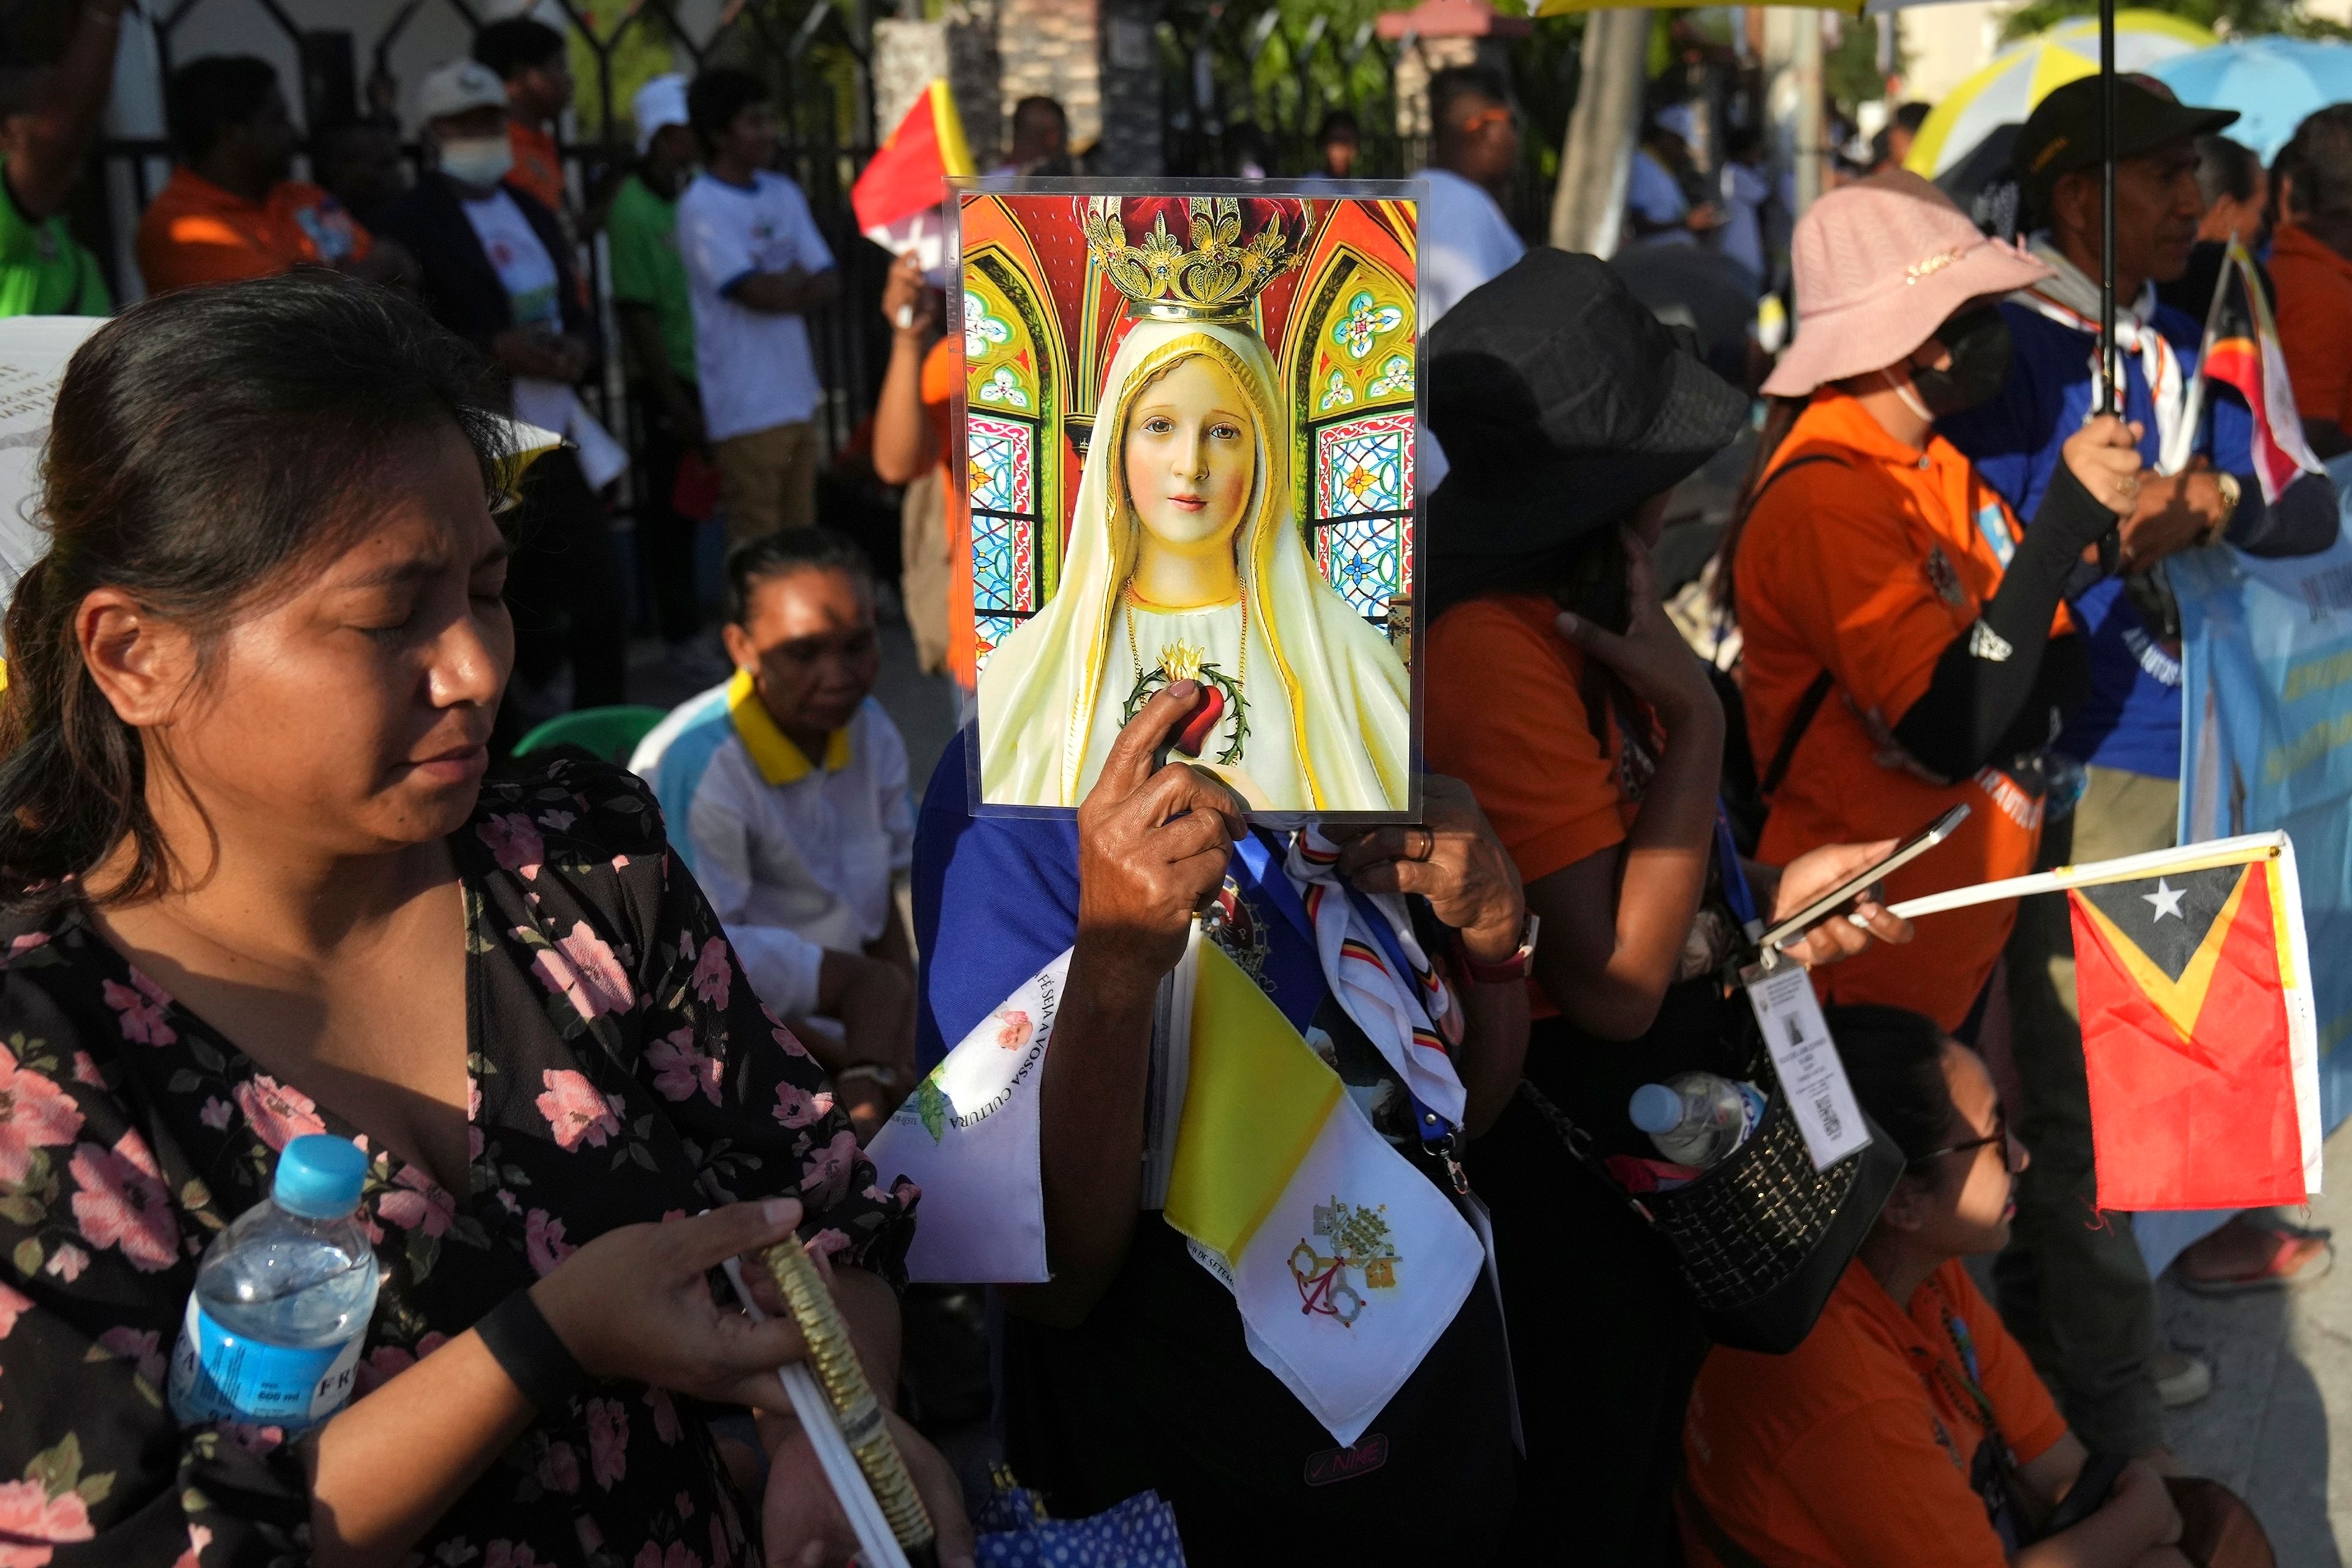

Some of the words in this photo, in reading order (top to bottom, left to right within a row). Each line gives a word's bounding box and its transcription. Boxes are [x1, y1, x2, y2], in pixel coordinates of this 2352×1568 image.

[1037, 974, 1055, 990] FÉ
[1042, 989, 1054, 1020] SEJA
[1039, 1023, 1049, 1033] A
[1011, 1037, 1047, 1085] VOSSA
[949, 1087, 1012, 1129] CULTURA
[1197, 1250, 1208, 1262] DE
[1207, 1259, 1234, 1286] SETEM
[1332, 1440, 1380, 1474] NIKE
